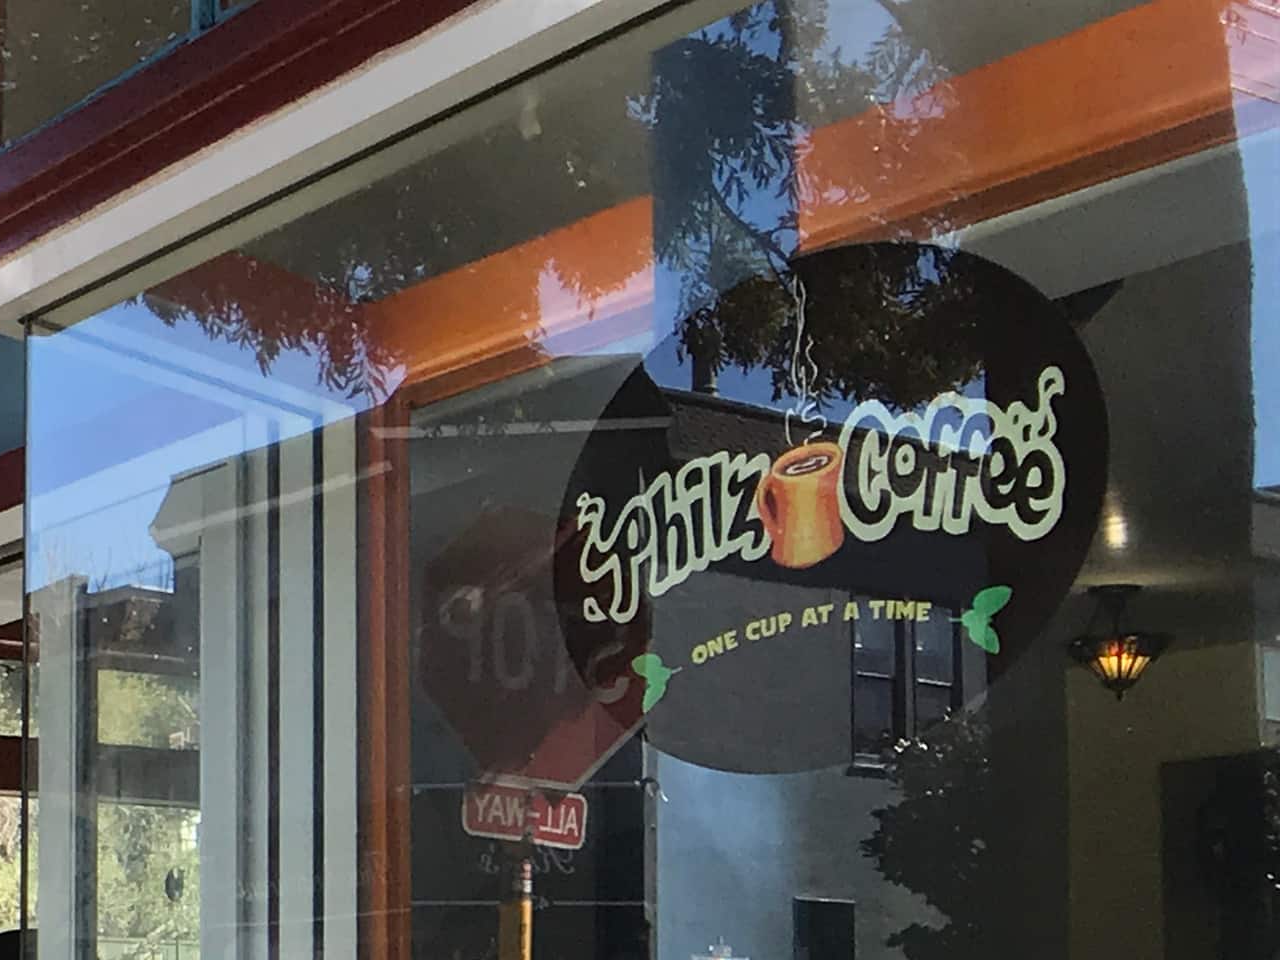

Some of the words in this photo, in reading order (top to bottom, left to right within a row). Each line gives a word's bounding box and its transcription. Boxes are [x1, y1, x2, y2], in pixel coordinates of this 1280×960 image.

[838, 366, 1066, 541] Coffee
[691, 630, 739, 665] ONE
[744, 612, 792, 641] CUP
[801, 604, 834, 628] AT
[843, 601, 860, 621] A
[869, 600, 932, 622] TIME
